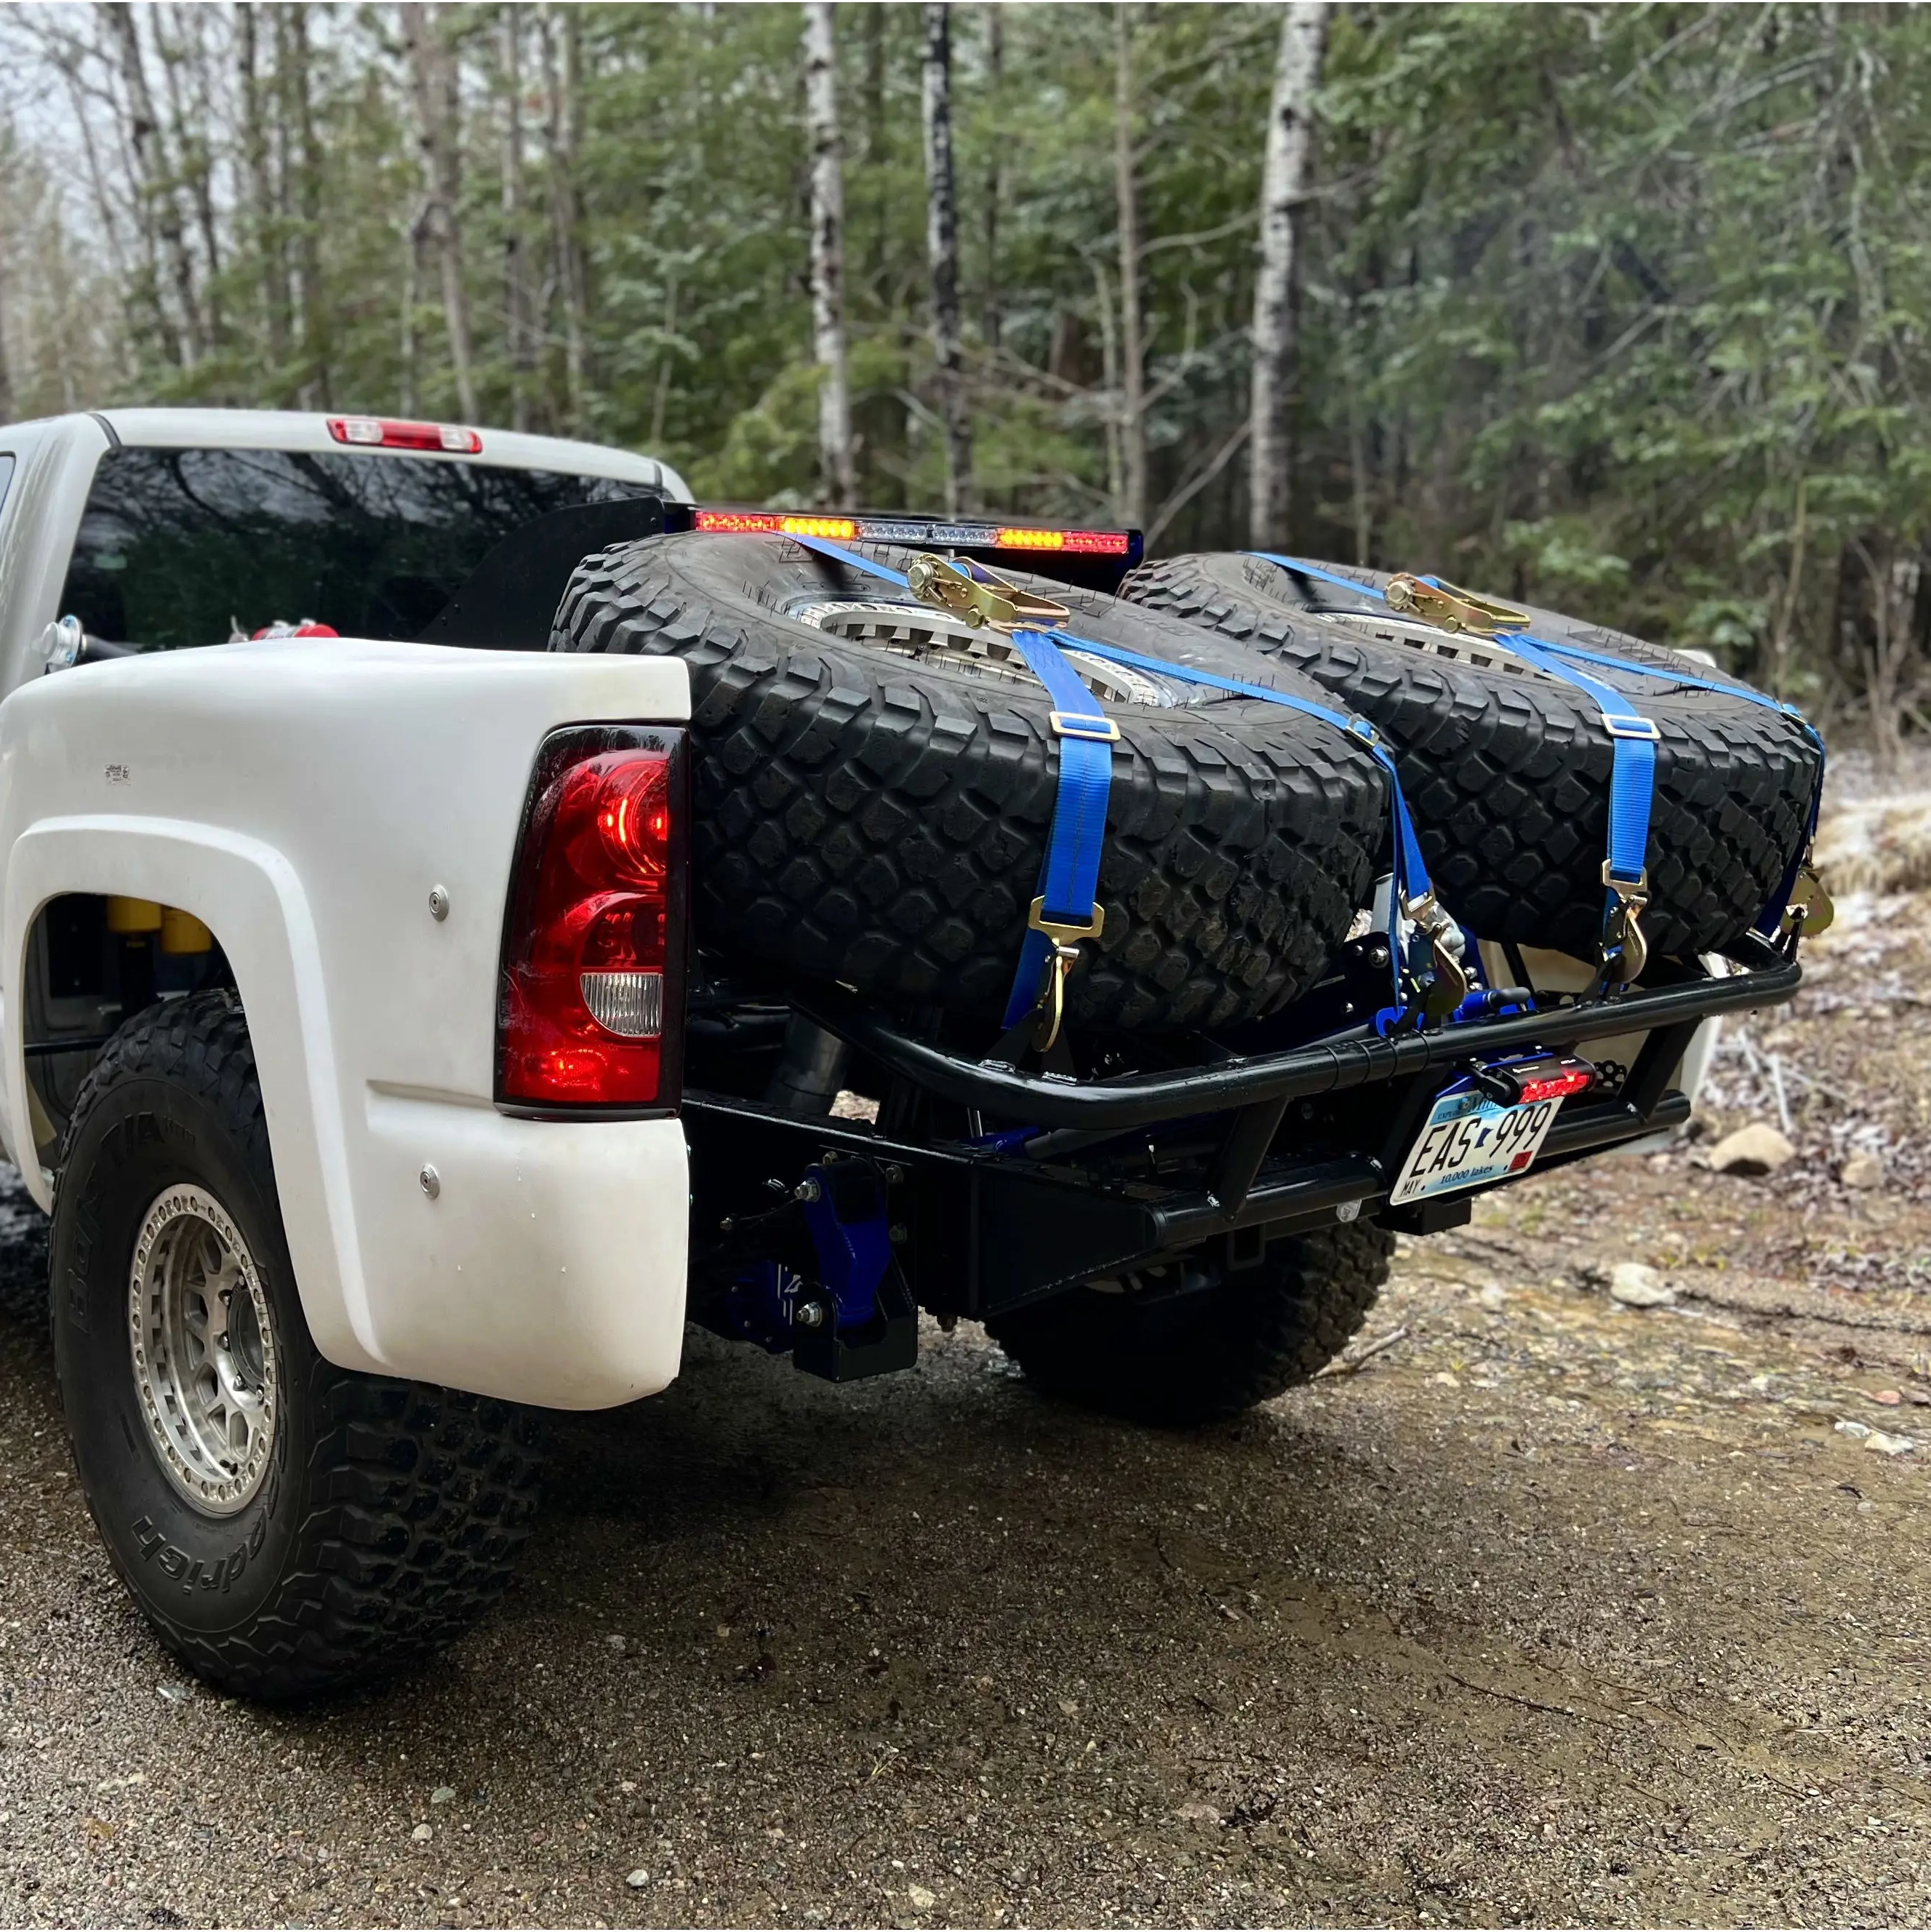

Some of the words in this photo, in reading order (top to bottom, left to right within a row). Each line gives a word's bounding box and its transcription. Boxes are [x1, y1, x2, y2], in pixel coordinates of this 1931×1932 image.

[1410, 1118, 1481, 1178] EAS
[1489, 1103, 1551, 1157] 999
[1470, 1165, 1493, 1176] lakes
[1401, 1178, 1420, 1197] MAY
